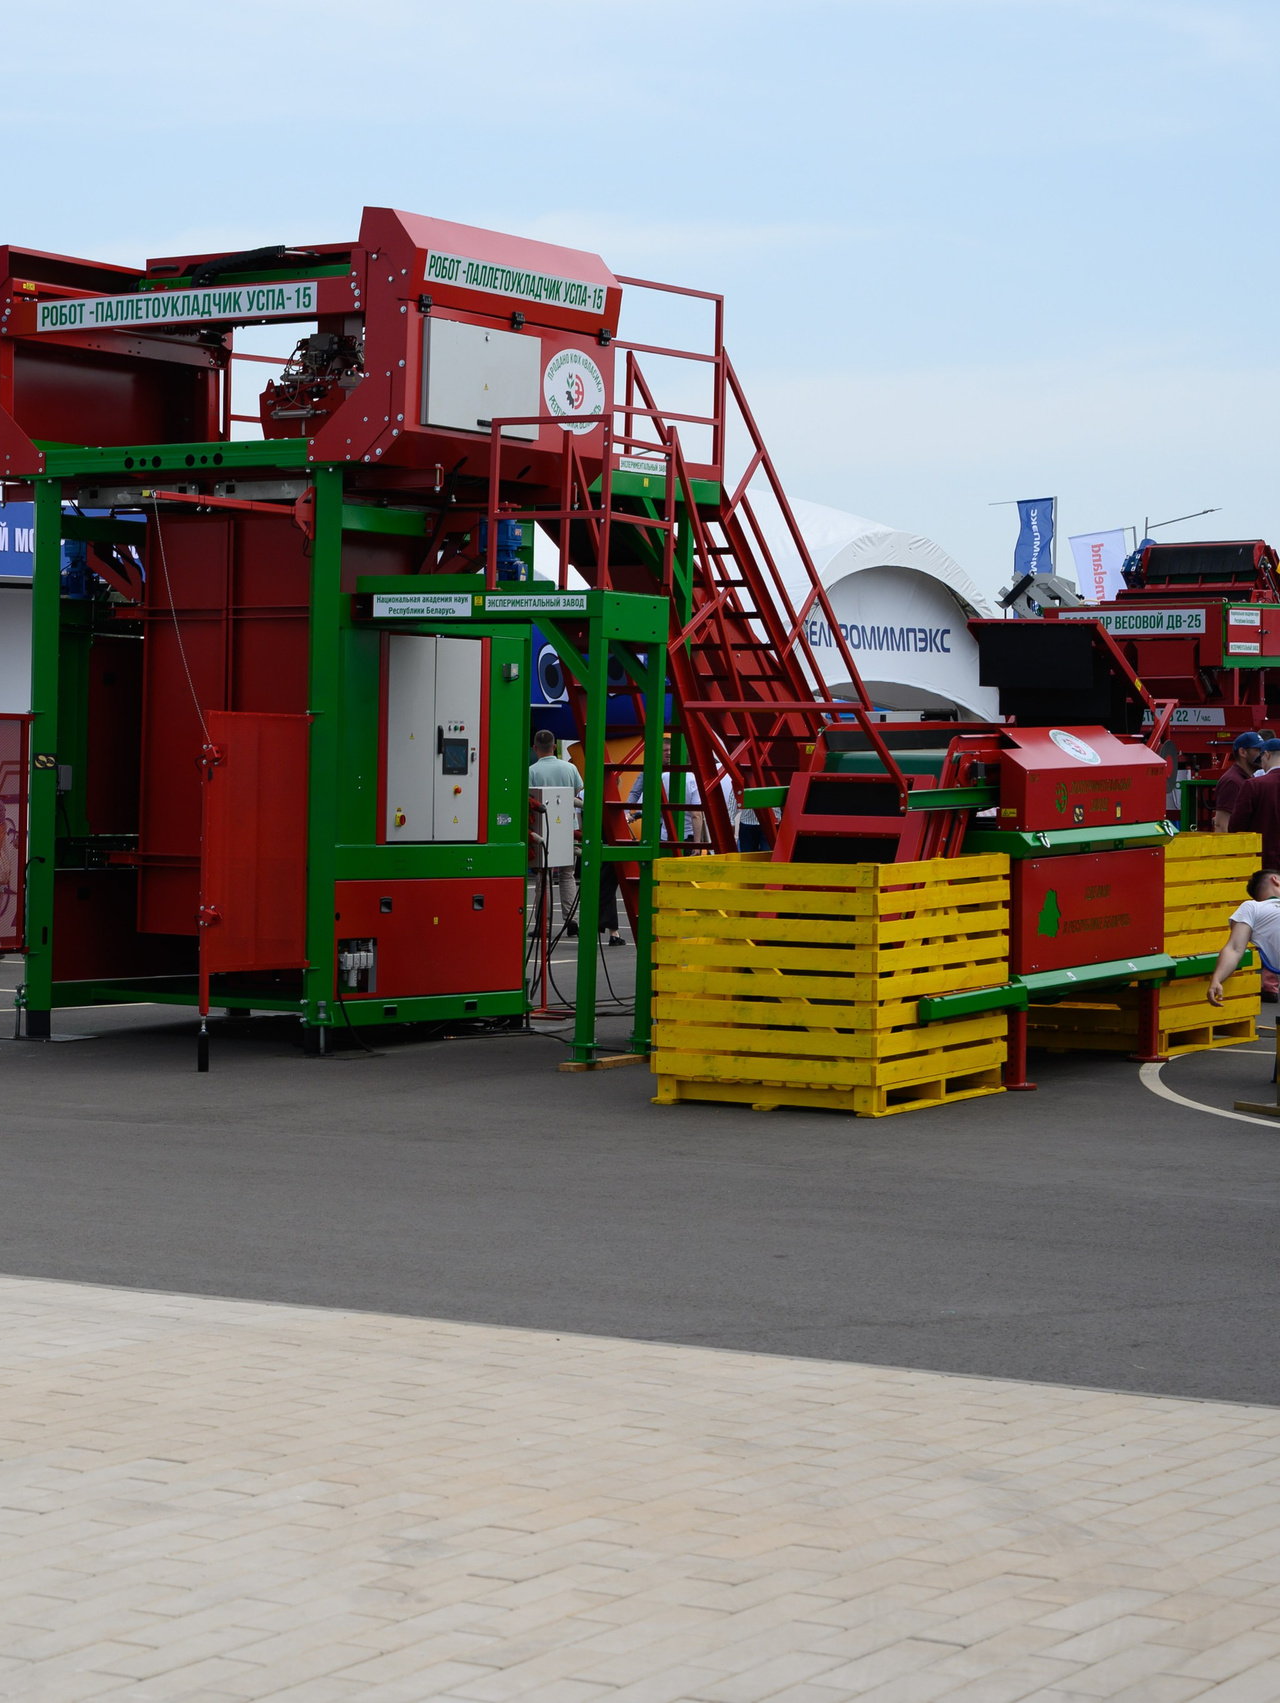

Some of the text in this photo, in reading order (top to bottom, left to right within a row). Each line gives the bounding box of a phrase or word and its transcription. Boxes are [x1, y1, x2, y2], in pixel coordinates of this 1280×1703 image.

[428, 254, 462, 282] РОБОТ
[41, 303, 86, 327] РОБОТ
[376, 596, 420, 604] Национальная
[422, 596, 452, 604] академия
[488, 597, 584, 608] ЭКСПЕРИМЕНТАЛЬНЫЙ ЗАВОД
[388, 606, 456, 616] Республики Беларусь
[1114, 612, 1164, 630] ВЕСОВОЙ
[1166, 614, 1202, 630] ДВ-25
[1176, 710, 1188, 722] 22
